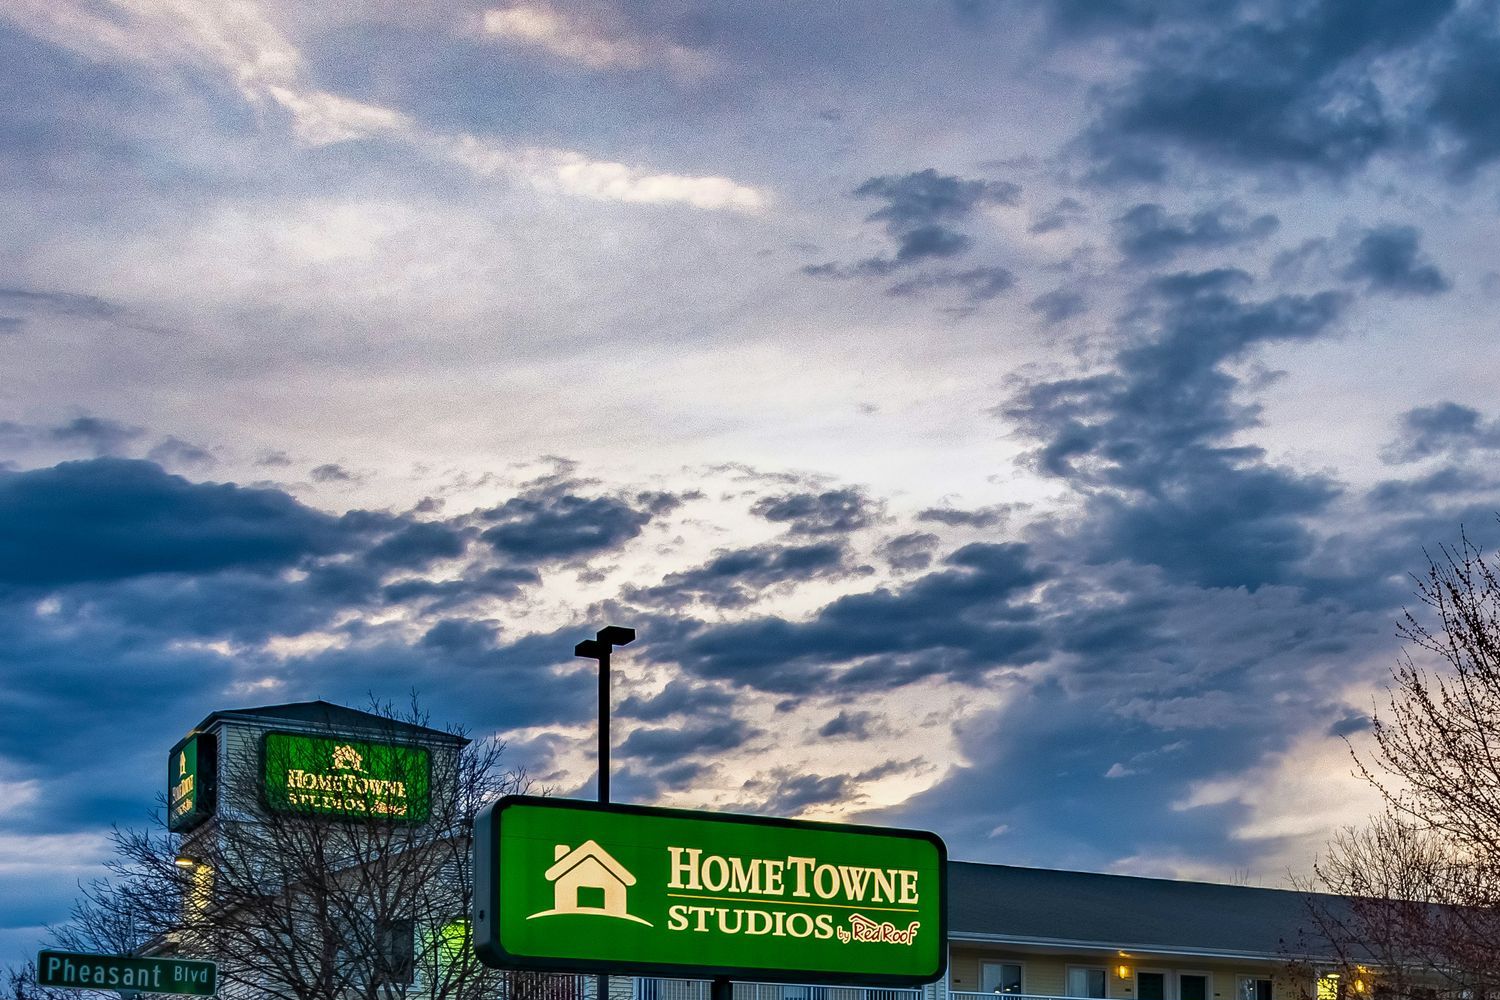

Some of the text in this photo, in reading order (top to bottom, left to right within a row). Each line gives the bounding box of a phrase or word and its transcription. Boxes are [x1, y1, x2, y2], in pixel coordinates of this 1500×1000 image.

[667, 846, 919, 904] HOMETOWNE
[668, 905, 834, 939] STUDIOS
[837, 926, 851, 944] by
[47, 957, 208, 988] Pheasant Blvd
